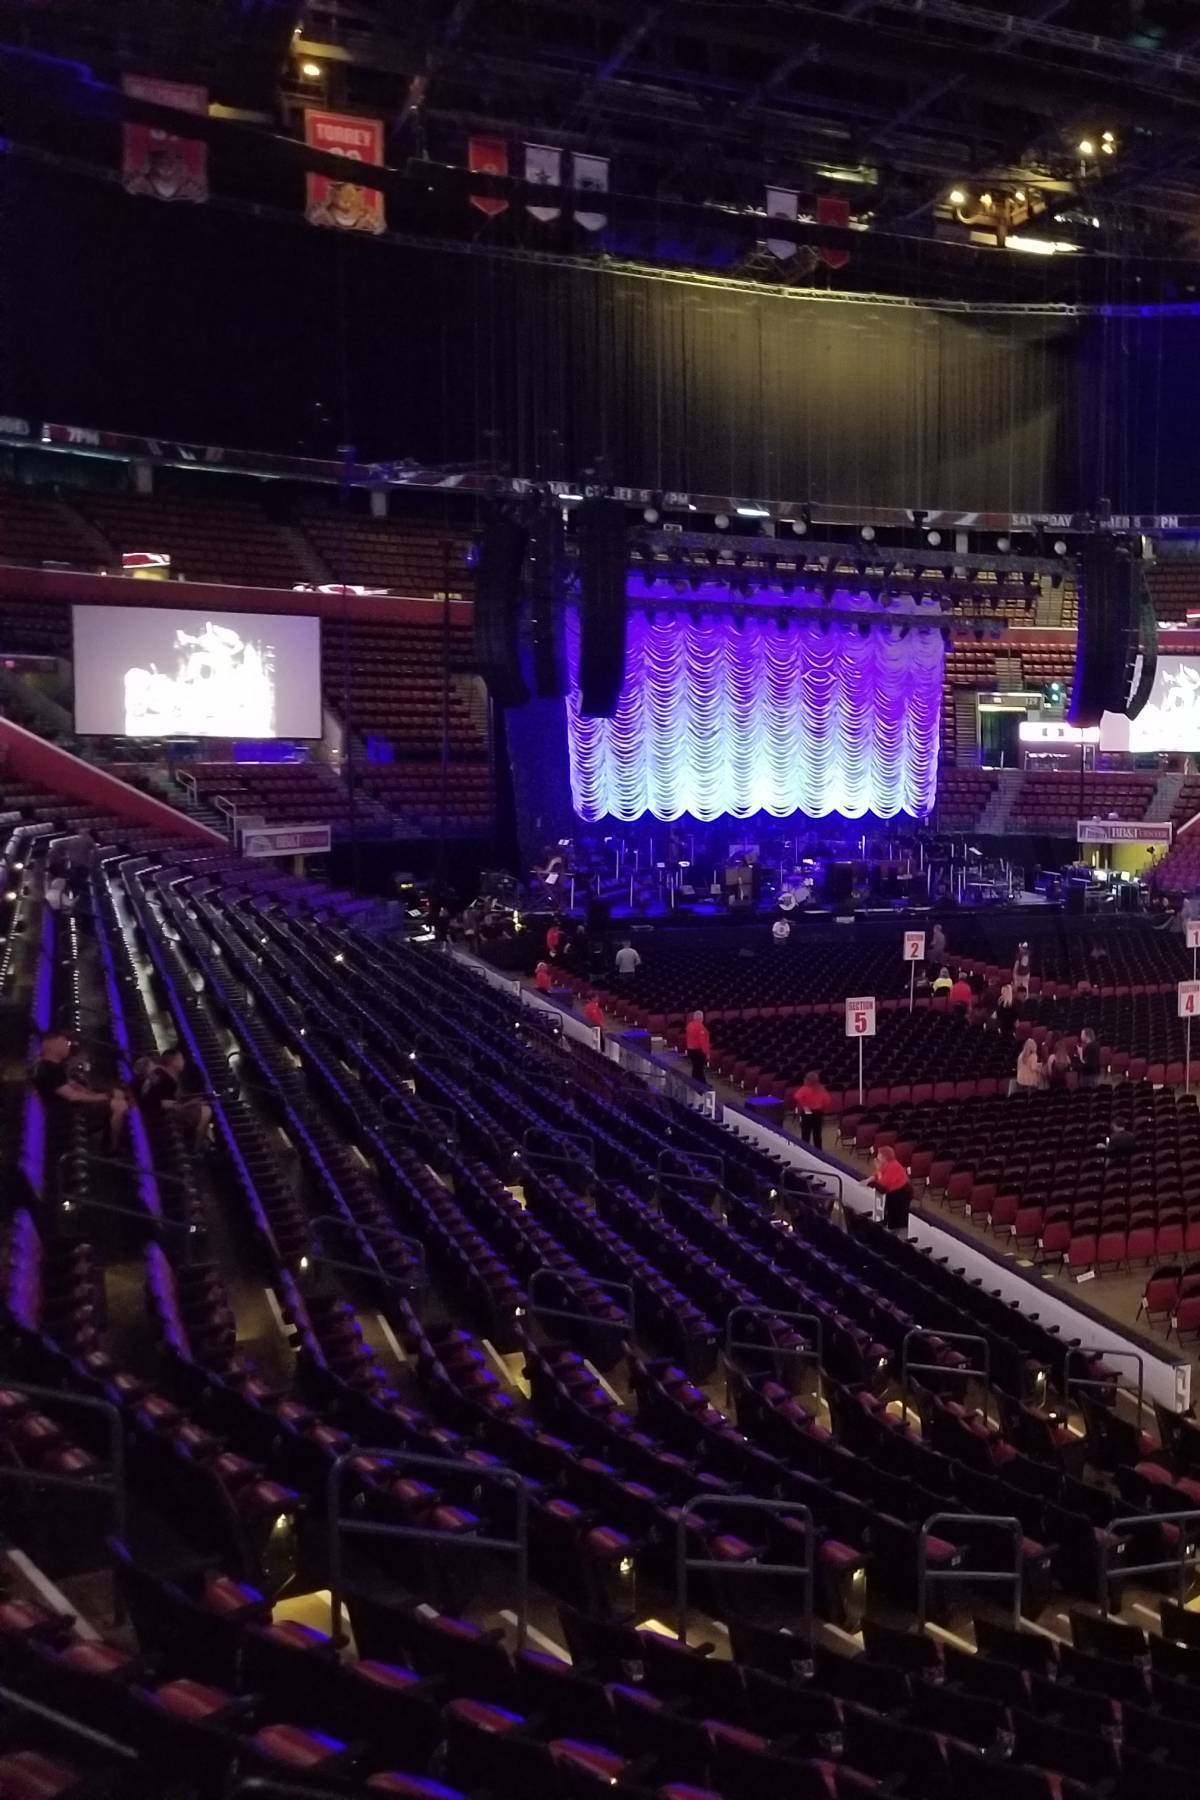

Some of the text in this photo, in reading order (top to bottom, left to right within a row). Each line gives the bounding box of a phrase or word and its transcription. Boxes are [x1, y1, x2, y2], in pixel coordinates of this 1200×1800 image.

[316, 123, 371, 146] TORREY
[1193, 930, 1199, 946] 1
[910, 942, 919, 958] 2
[1185, 994, 1194, 1013] 4
[855, 1012, 867, 1033] 5
